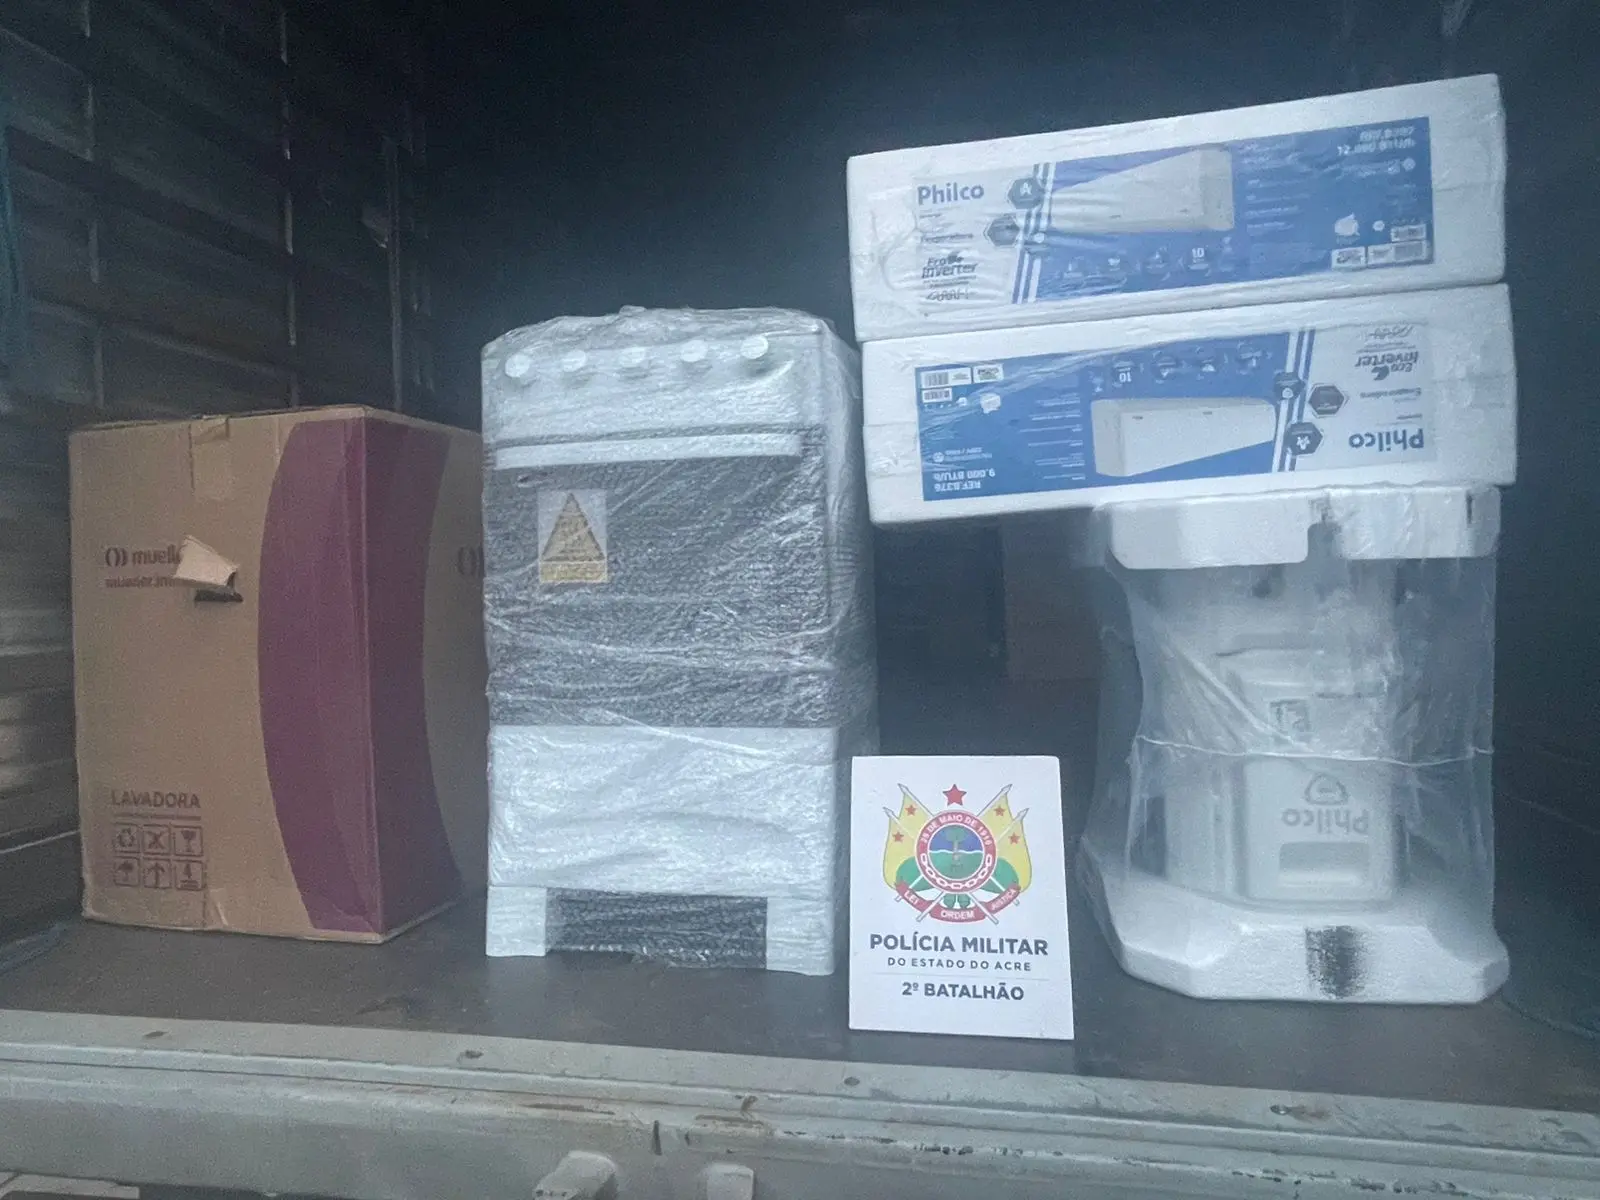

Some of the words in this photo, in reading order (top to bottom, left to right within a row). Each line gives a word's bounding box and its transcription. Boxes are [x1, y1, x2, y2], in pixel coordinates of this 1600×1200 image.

[917, 181, 985, 206] Philco
[1354, 351, 1419, 368] Inverter
[1390, 362, 1413, 373] Eco
[1348, 428, 1425, 453] Philco
[111, 789, 202, 809] LAVADORA
[927, 821, 938, 833] DE
[938, 814, 963, 824] MAIO
[964, 816, 977, 827] DE
[1281, 807, 1370, 835] Philco
[903, 889, 920, 906] LEI
[940, 909, 975, 919] ORDEM
[870, 931, 956, 953] POLÍCIA
[961, 937, 1049, 956] MILITAR
[887, 957, 906, 967] DO
[911, 957, 966, 969] ESTADO
[970, 960, 990, 970] DO
[994, 961, 1032, 972] ACRE
[901, 982, 919, 997] 2º
[924, 981, 1025, 1001] BATALHÃO
